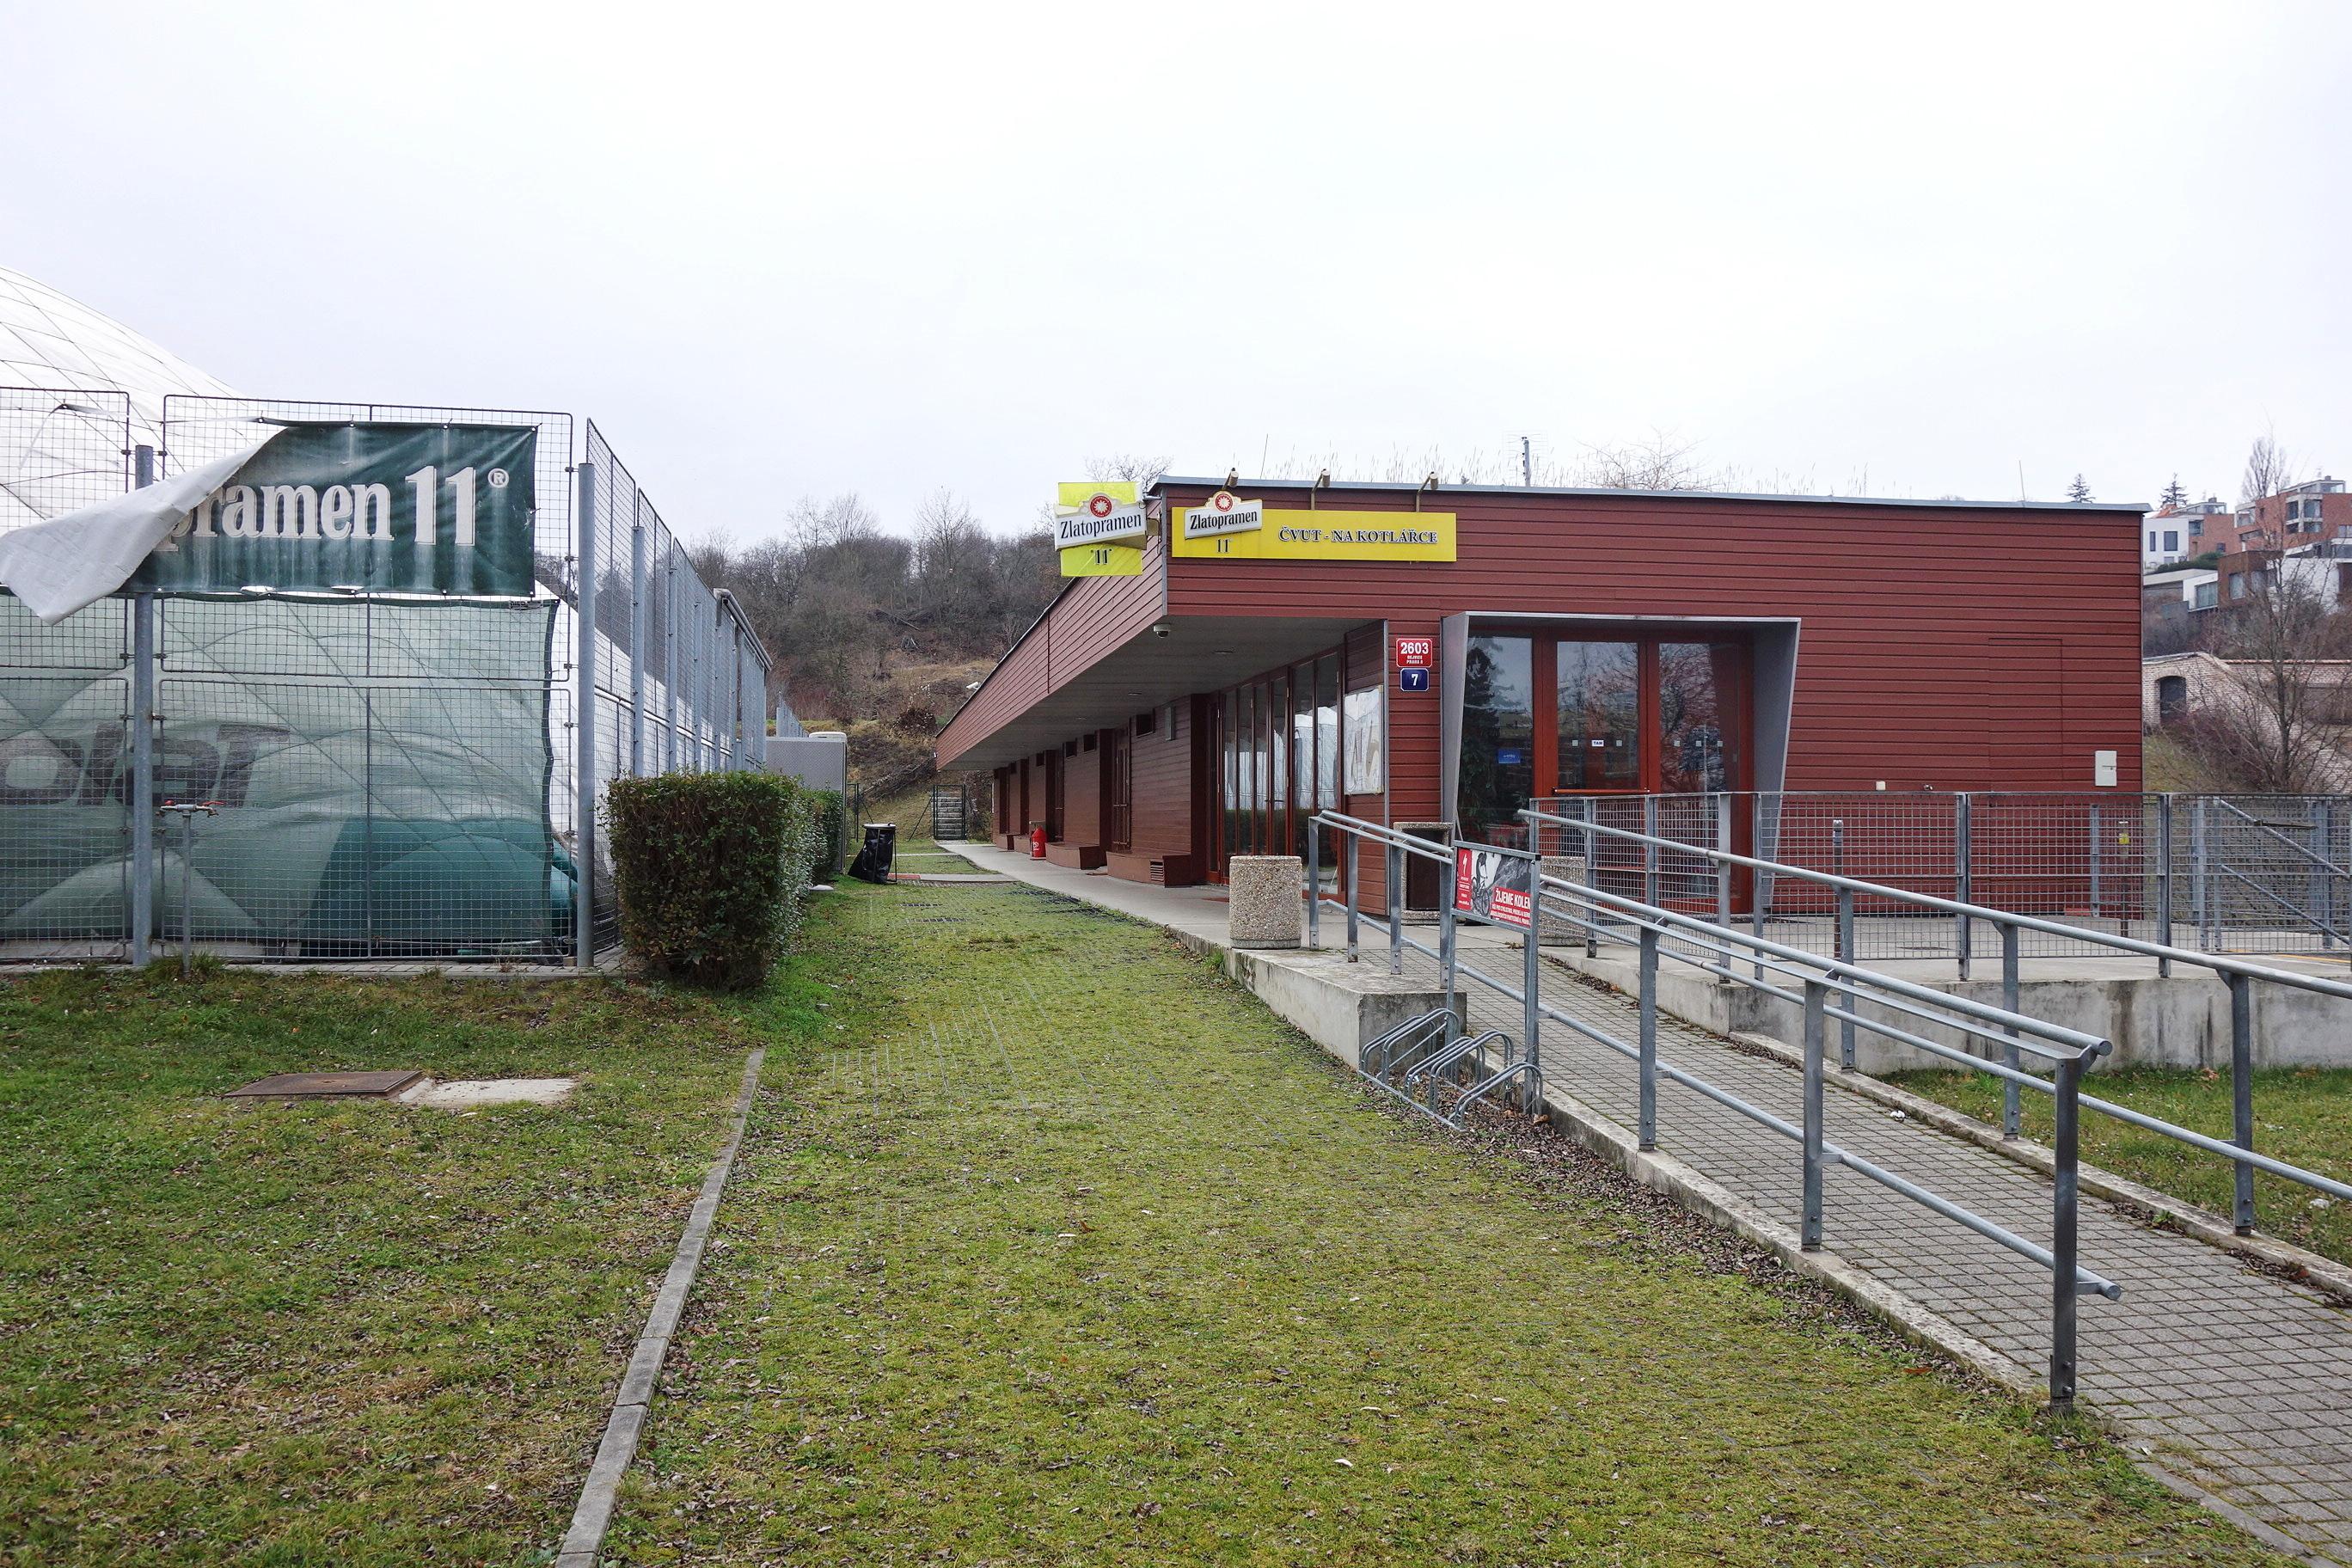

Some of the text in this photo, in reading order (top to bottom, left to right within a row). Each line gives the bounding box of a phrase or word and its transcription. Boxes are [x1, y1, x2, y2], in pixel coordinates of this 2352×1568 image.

[1060, 513, 1142, 539] Zlatopramen
[1190, 511, 1258, 530] Zlatopramen
[1278, 525, 1321, 542] ČVUT
[1332, 530, 1354, 542] NA
[1357, 529, 1438, 544] KOTLÁŘCE
[1400, 642, 1429, 654] 2603
[1411, 673, 1418, 686] 7
[1495, 888, 1514, 906] ŽIJEME
